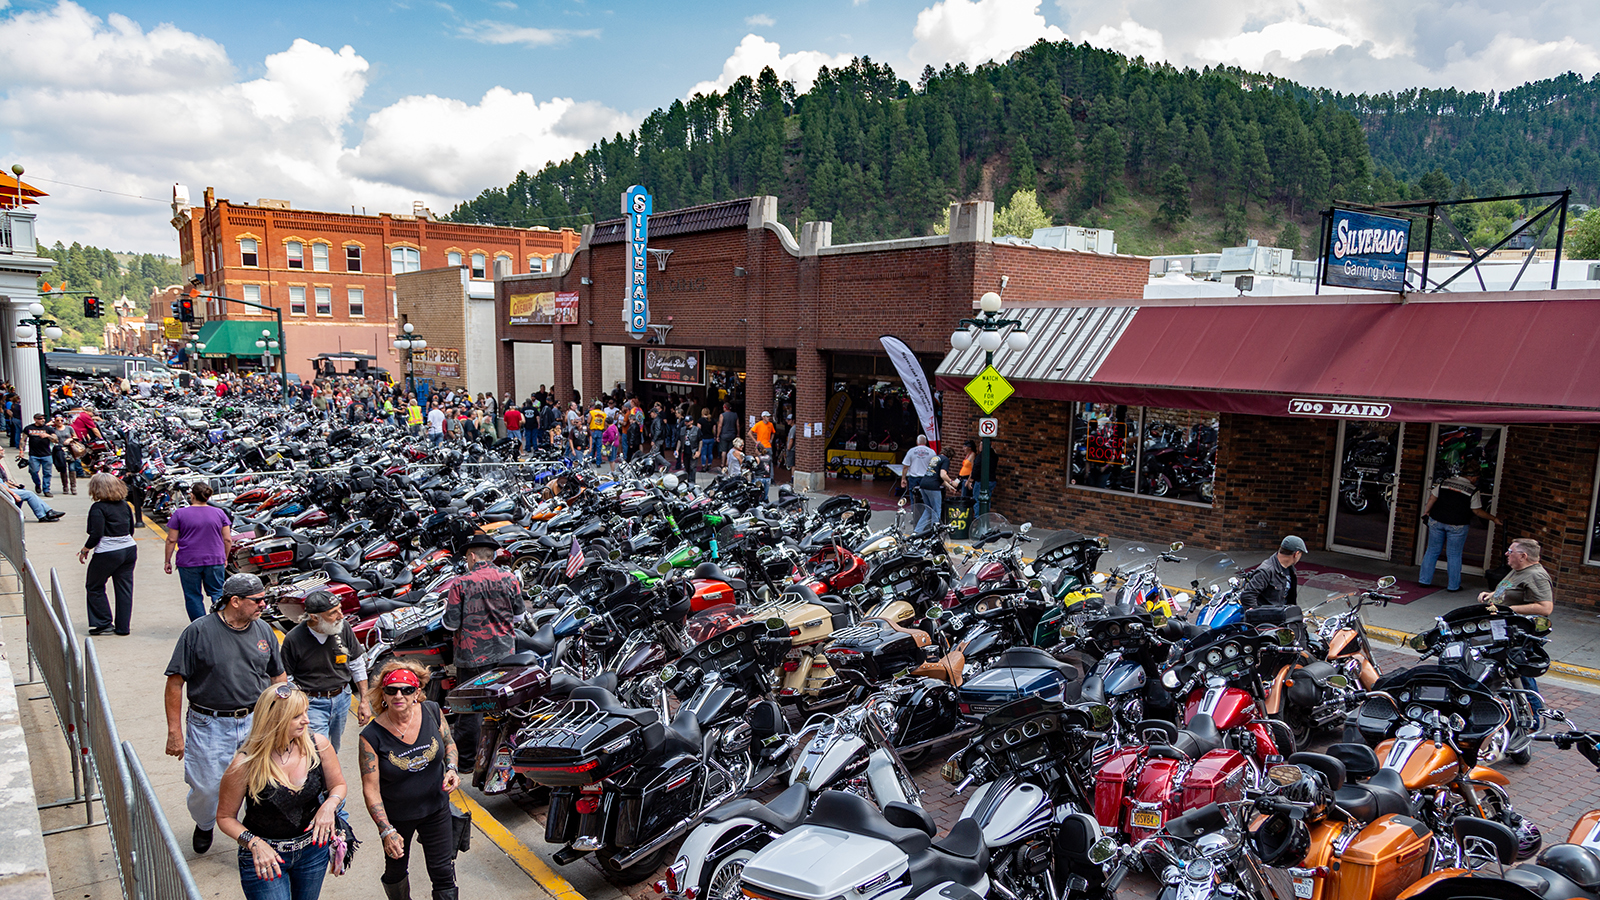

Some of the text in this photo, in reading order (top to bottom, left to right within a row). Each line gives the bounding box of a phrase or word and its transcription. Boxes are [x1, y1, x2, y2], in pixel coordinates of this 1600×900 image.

[1334, 218, 1405, 259] SILVERADO
[633, 194, 646, 329] SILVERADO
[1344, 260, 1397, 281] Gaming Est.
[440, 350, 459, 364] BEER
[828, 394, 847, 430] STRIDER
[1294, 401, 1386, 416] 709 MAIN
[1097, 425, 1118, 437] LIVE
[1090, 435, 1124, 448] POKER
[1089, 447, 1123, 461] ROOM
